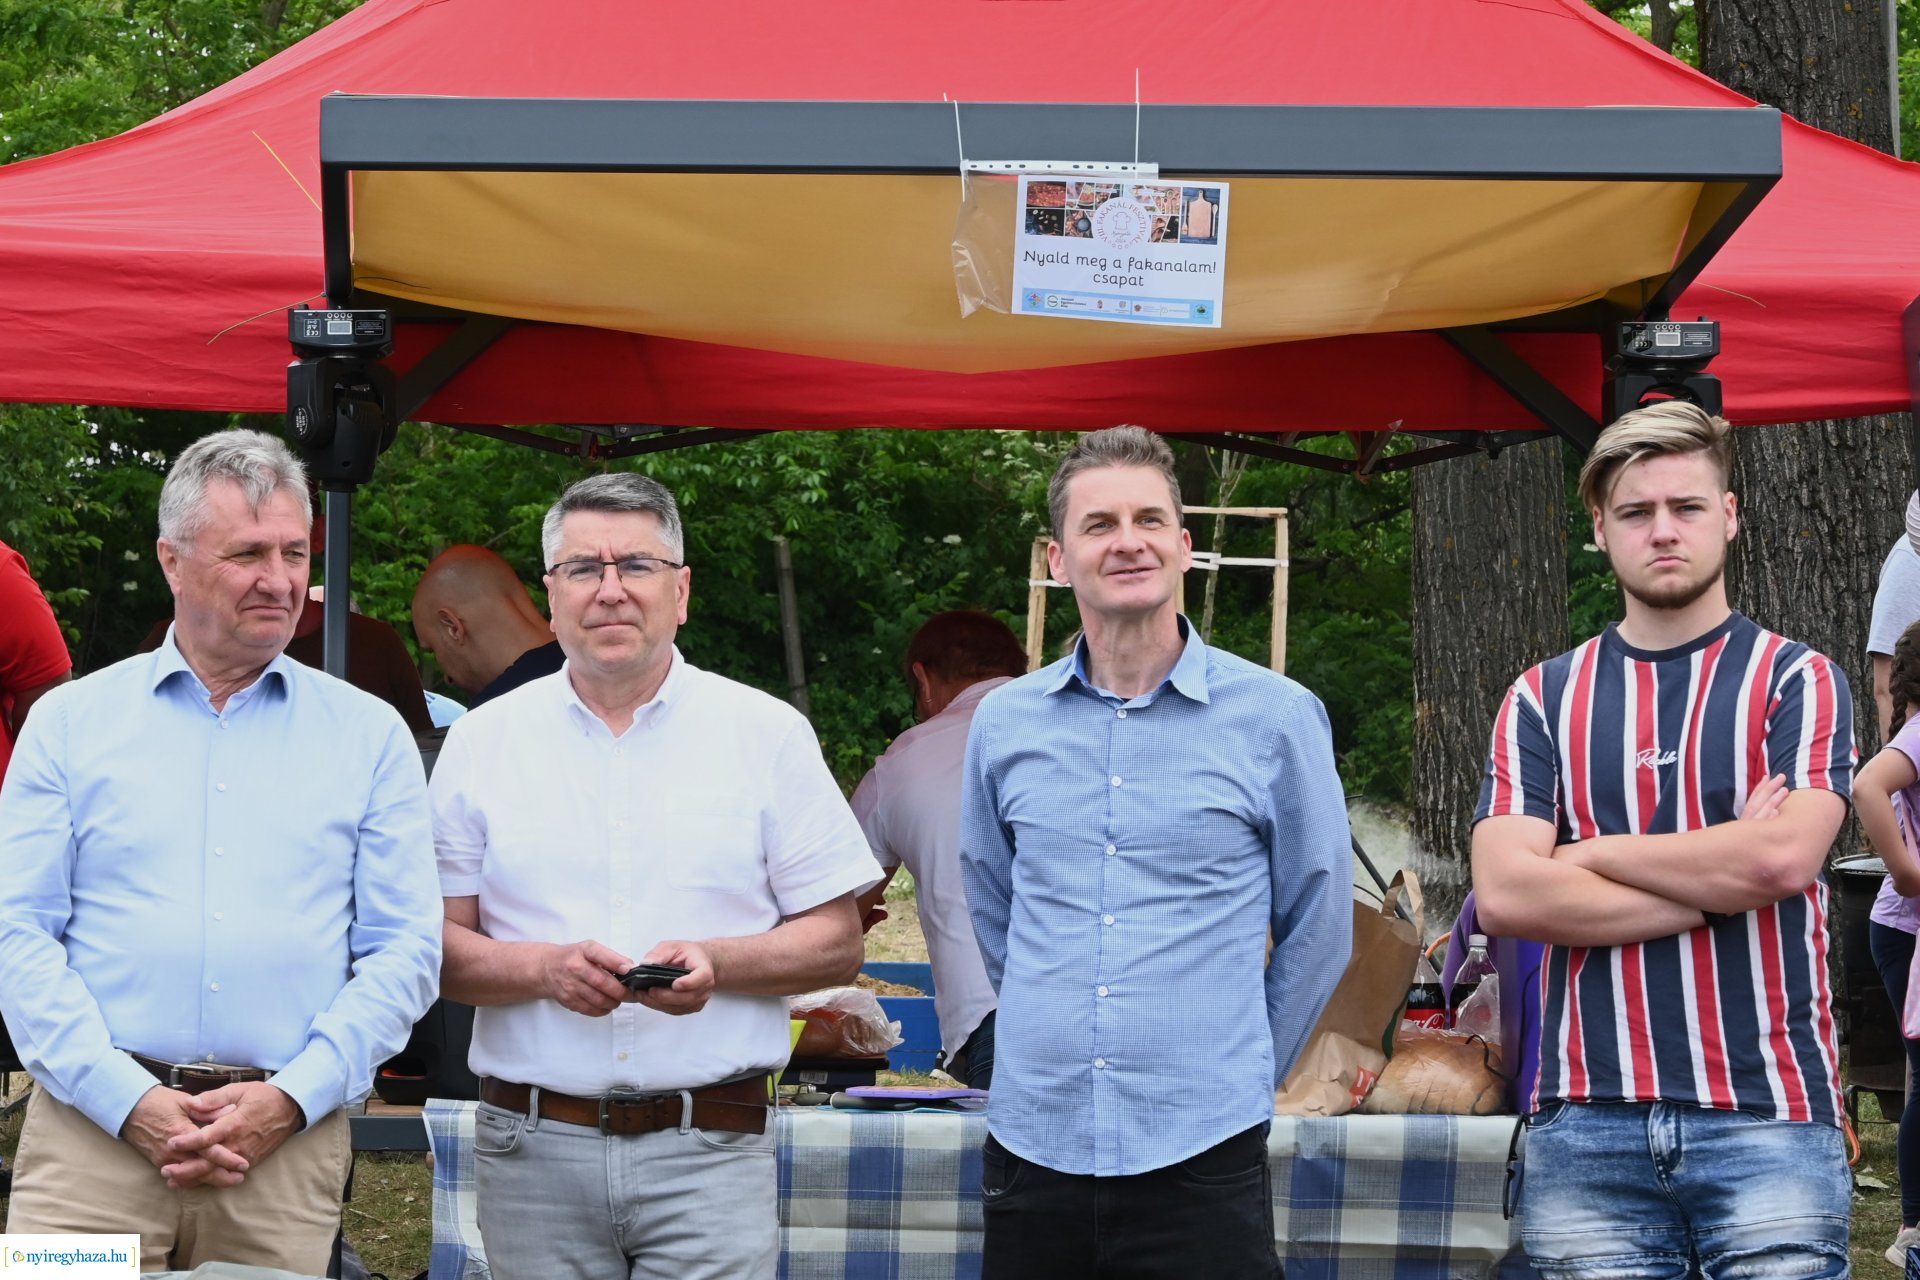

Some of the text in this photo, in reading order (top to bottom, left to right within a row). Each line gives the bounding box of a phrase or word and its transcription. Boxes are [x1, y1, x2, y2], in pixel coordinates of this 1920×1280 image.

[1023, 250, 1217, 274] Nyald meg a fakanalam!
[1092, 272, 1145, 288] csapat
